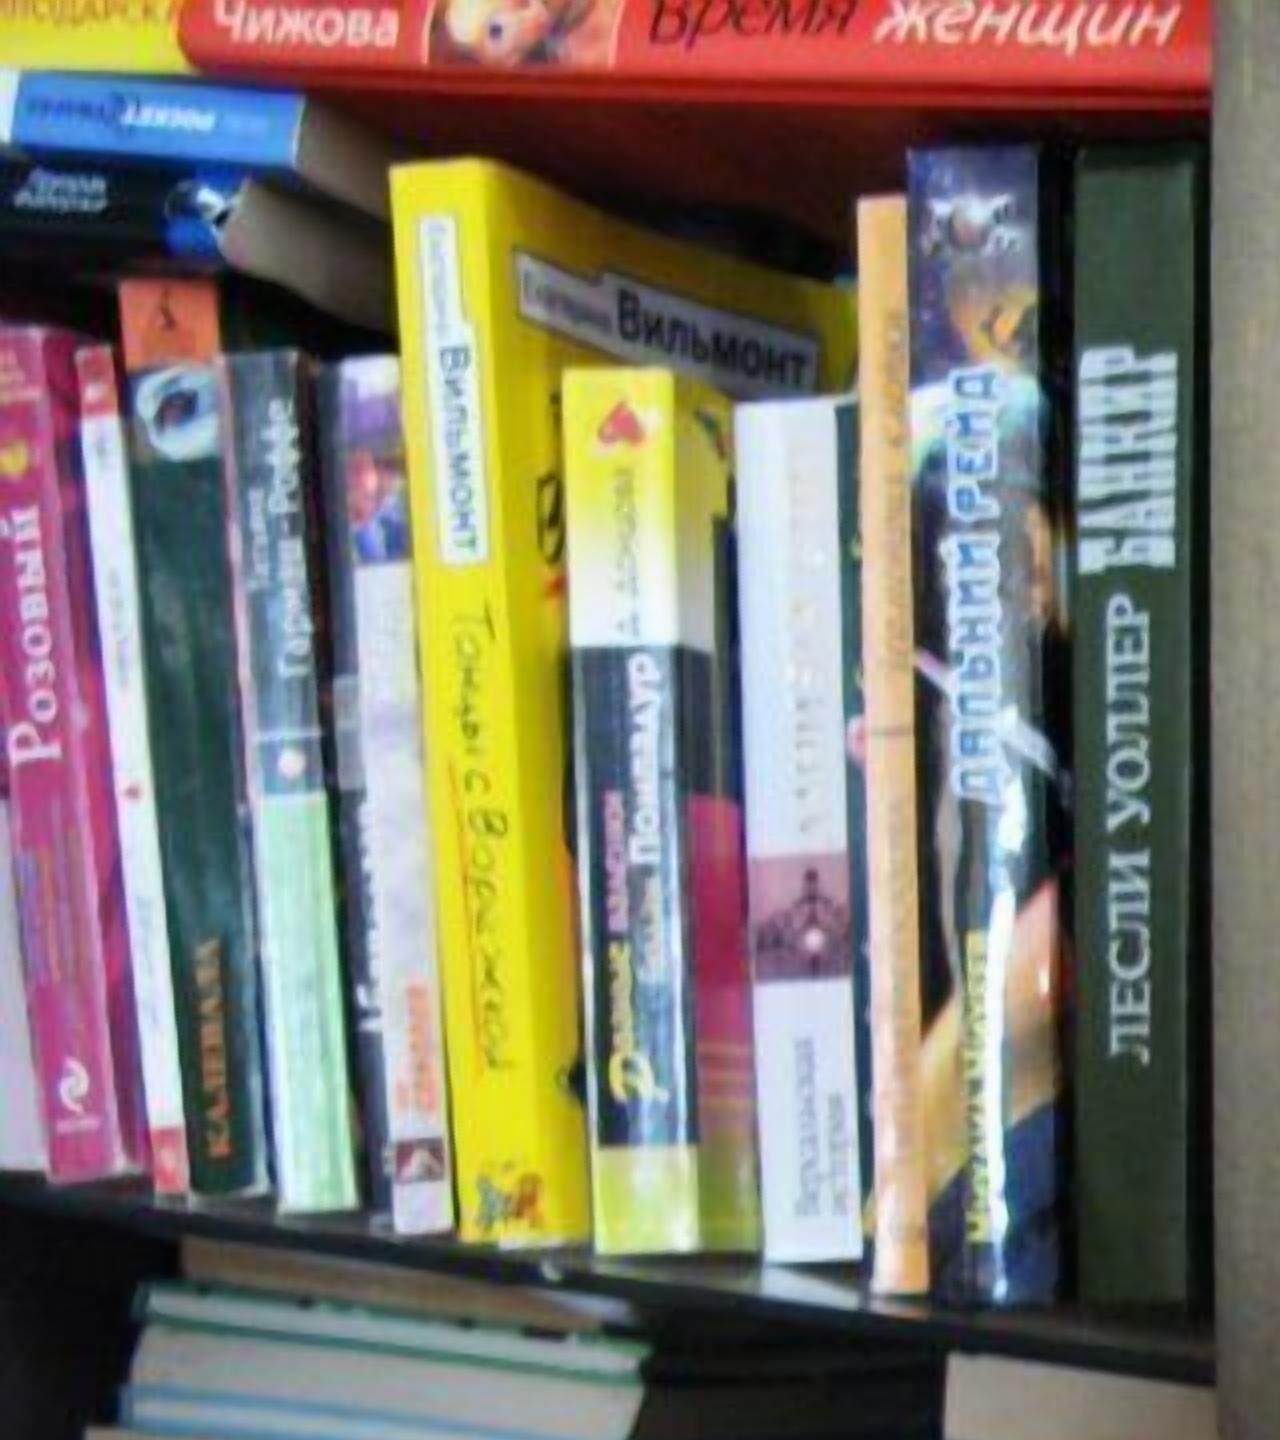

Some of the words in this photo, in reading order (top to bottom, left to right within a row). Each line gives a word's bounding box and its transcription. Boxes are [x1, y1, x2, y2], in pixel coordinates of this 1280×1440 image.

[873, 0, 1181, 55] женщин
[616, 292, 808, 386] Вильмонт
[945, 366, 1001, 520] РЕЙД
[439, 345, 481, 553] Вильмонт
[1078, 346, 1177, 574] БАНКИР
[8, 505, 62, 766] Розовый
[940, 532, 1004, 803] ДАЛЬНИЙ
[1106, 593, 1150, 827] УОЛЛЕР
[1108, 849, 1149, 1065] ЛЕСЛИ
